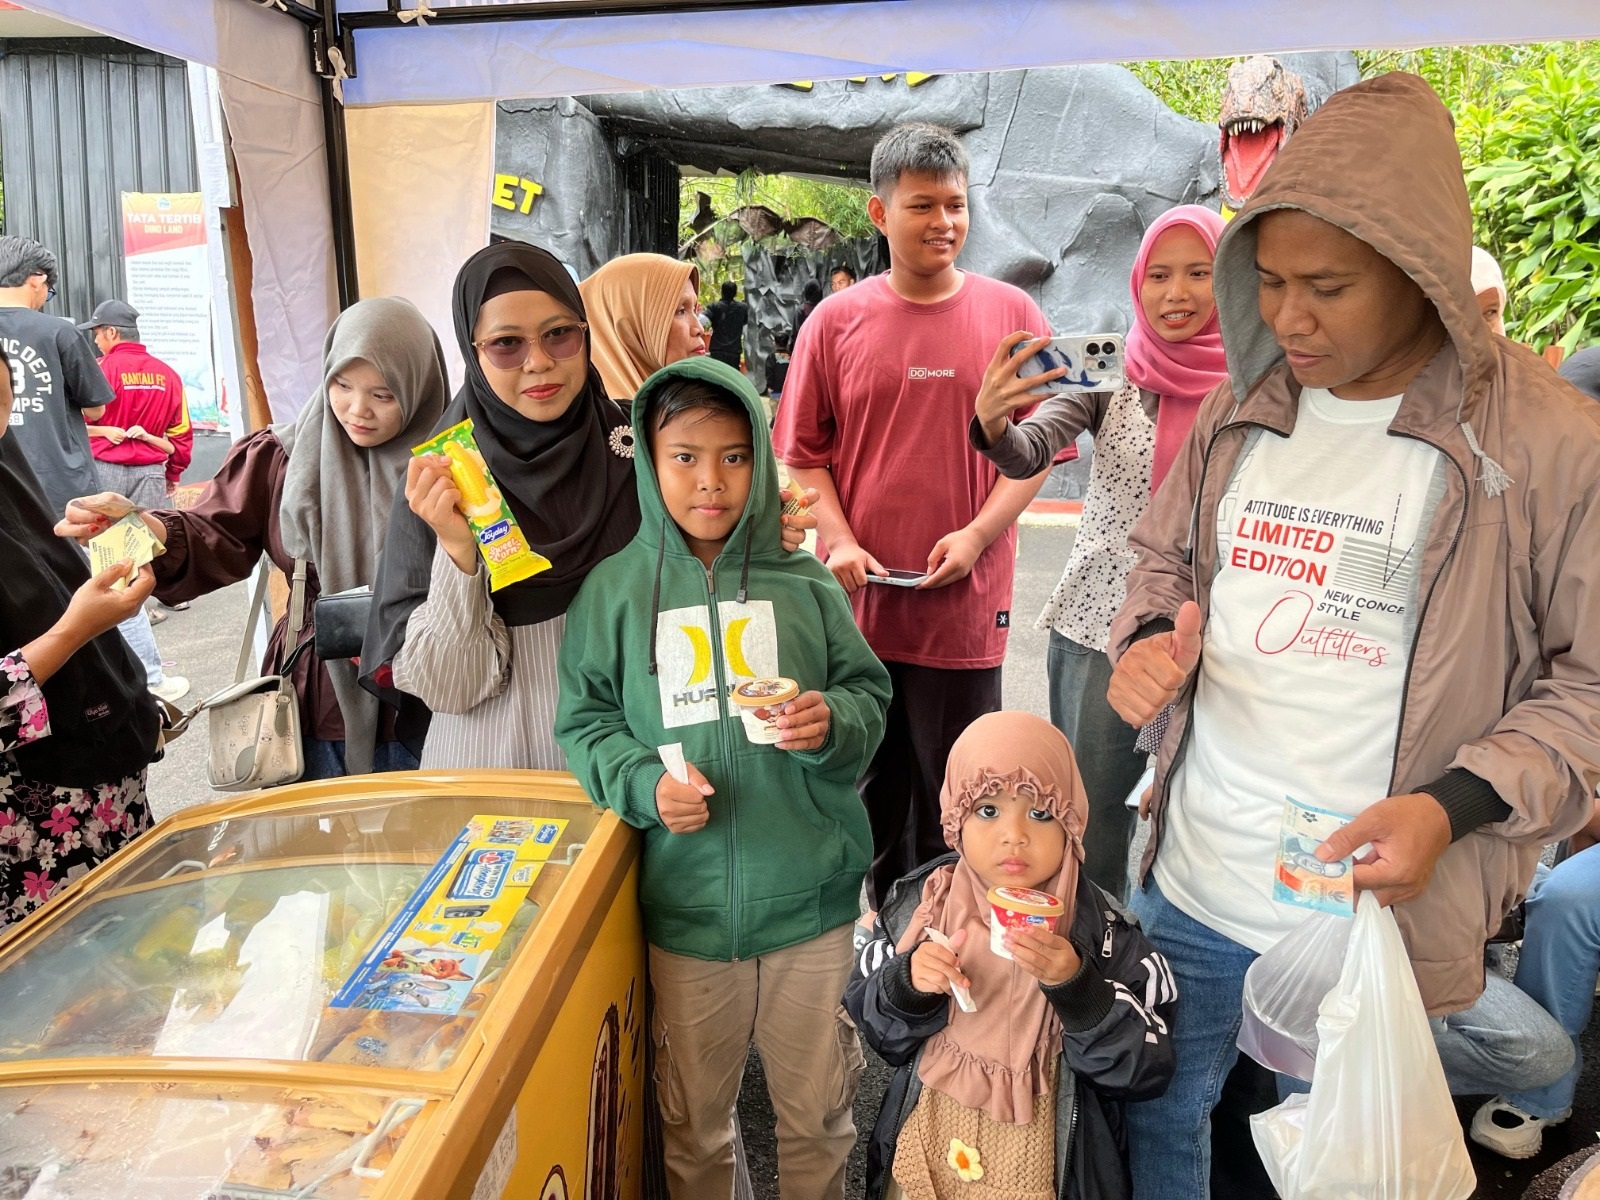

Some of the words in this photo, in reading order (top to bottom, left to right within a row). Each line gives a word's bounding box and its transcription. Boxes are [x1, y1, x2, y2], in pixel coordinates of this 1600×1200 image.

[127, 213, 156, 223] TATA
[158, 213, 202, 224] TERTIB
[163, 225, 183, 234] LAND
[121, 372, 154, 385] RANTAU
[156, 373, 166, 387] FC
[909, 368, 926, 378] DO
[927, 369, 955, 377] MORE
[1244, 500, 1297, 521] ATTITUDE
[1297, 508, 1310, 523] IS
[1311, 509, 1385, 536] EVERYTHING
[480, 524, 508, 544] Joyday
[1236, 517, 1335, 554] LIMITED
[1231, 547, 1327, 587] EDITION
[1324, 589, 1354, 605] NEW
[1317, 602, 1361, 622] STYLE
[1255, 590, 1390, 667] Outfitters
